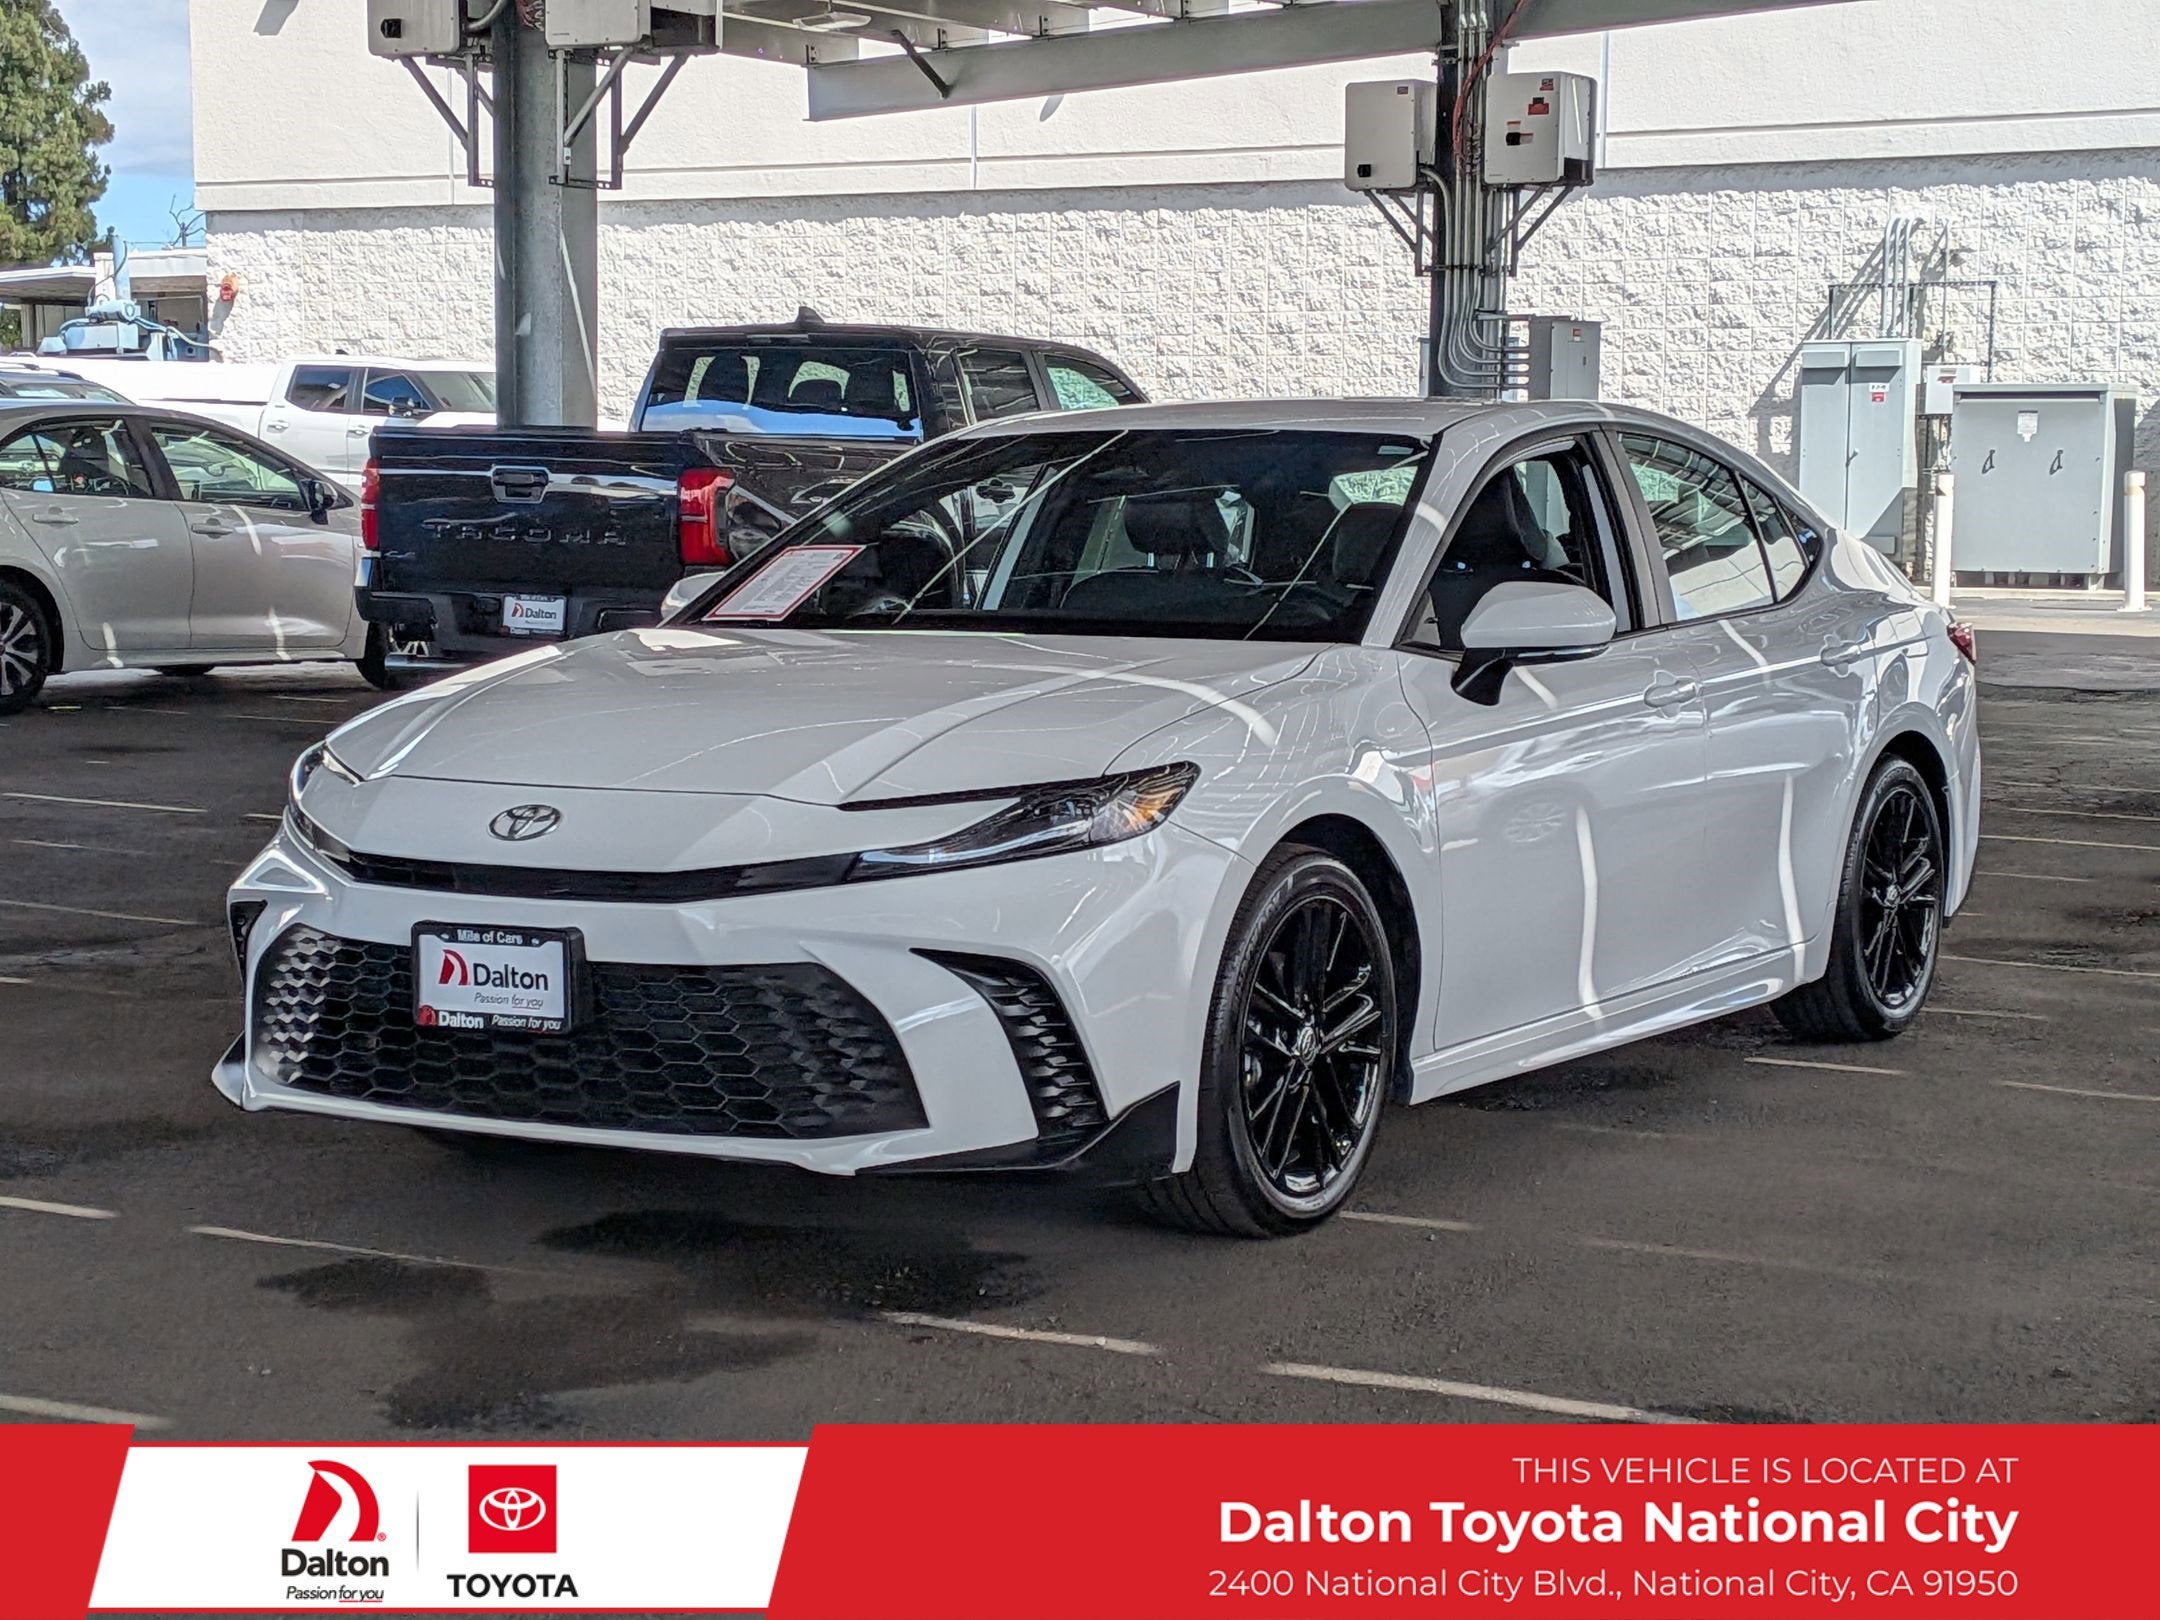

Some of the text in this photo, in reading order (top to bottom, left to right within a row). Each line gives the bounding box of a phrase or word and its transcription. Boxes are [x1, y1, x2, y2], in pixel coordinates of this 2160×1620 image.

[525, 607, 557, 619] Dalton
[457, 929, 523, 945] Mile of Cars
[474, 963, 548, 991] Dalton
[474, 992, 544, 1008] Passion for you
[439, 1011, 562, 1031] Dalton Passion for you
